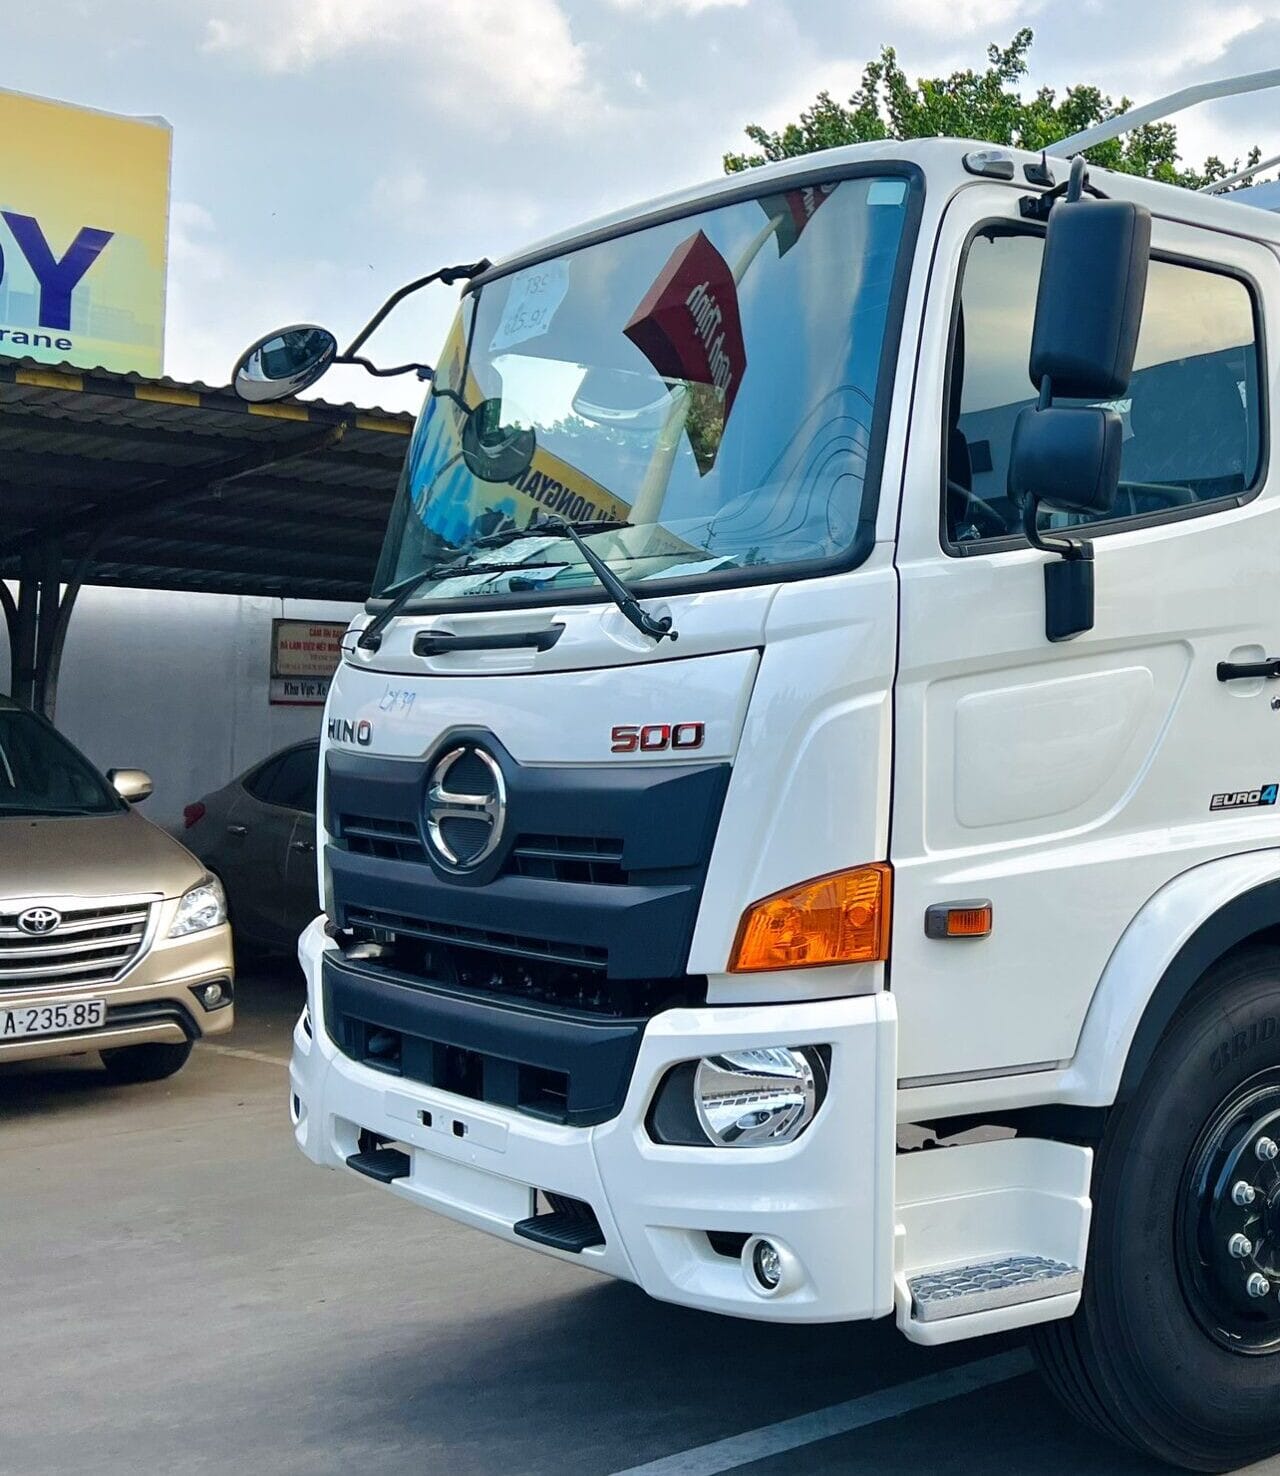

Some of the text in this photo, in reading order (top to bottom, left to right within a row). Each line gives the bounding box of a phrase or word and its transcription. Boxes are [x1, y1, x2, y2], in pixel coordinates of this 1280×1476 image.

[0, 211, 115, 331] Y
[327, 717, 373, 746] HINO
[611, 721, 705, 753] 500
[4, 1002, 101, 1034] A-235.85
